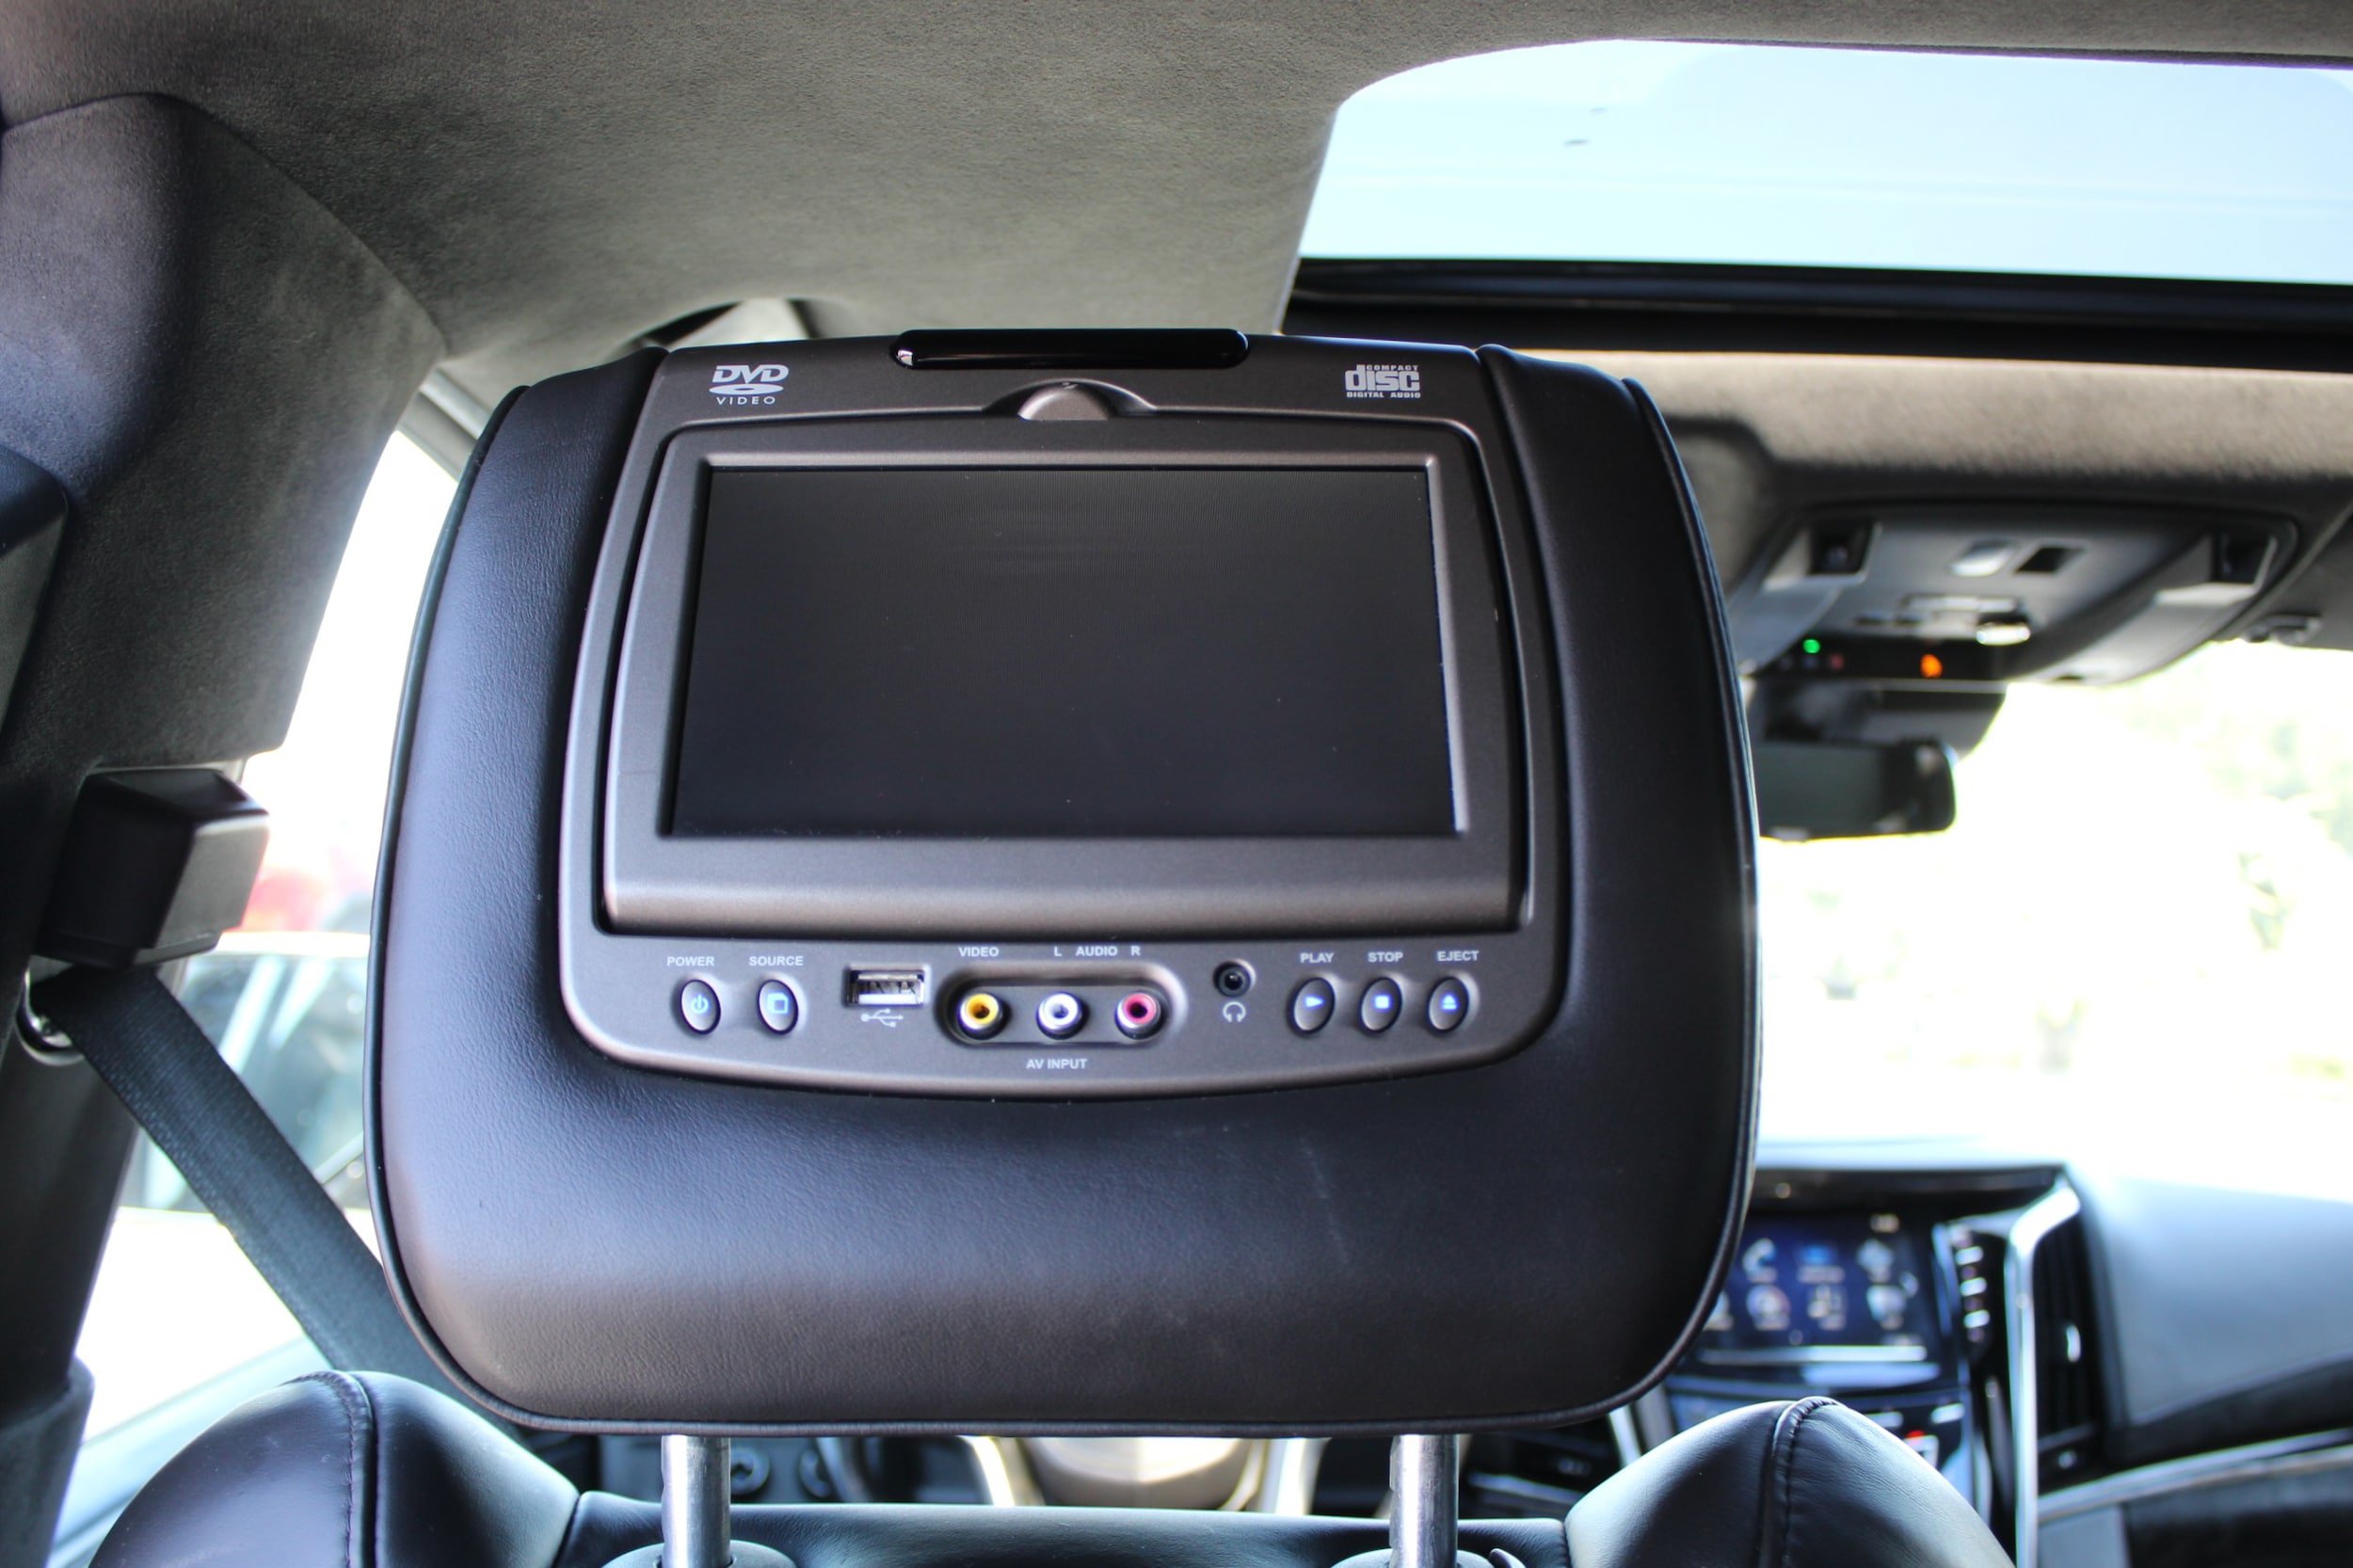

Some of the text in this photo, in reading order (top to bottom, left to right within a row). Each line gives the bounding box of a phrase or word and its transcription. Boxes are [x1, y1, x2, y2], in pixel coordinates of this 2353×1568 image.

[712, 364, 790, 384] DVD
[716, 395, 776, 405] VIDEO
[958, 946, 1000, 957] VIDEO
[1053, 946, 1141, 957] L AUDIO R
[1436, 950, 1480, 962] EJECT
[666, 955, 715, 967] POWER
[748, 955, 804, 967] SOURCE
[1300, 952, 1335, 964] PLAY
[1368, 952, 1403, 963] STOP
[1026, 1058, 1088, 1069] AV INPUT
